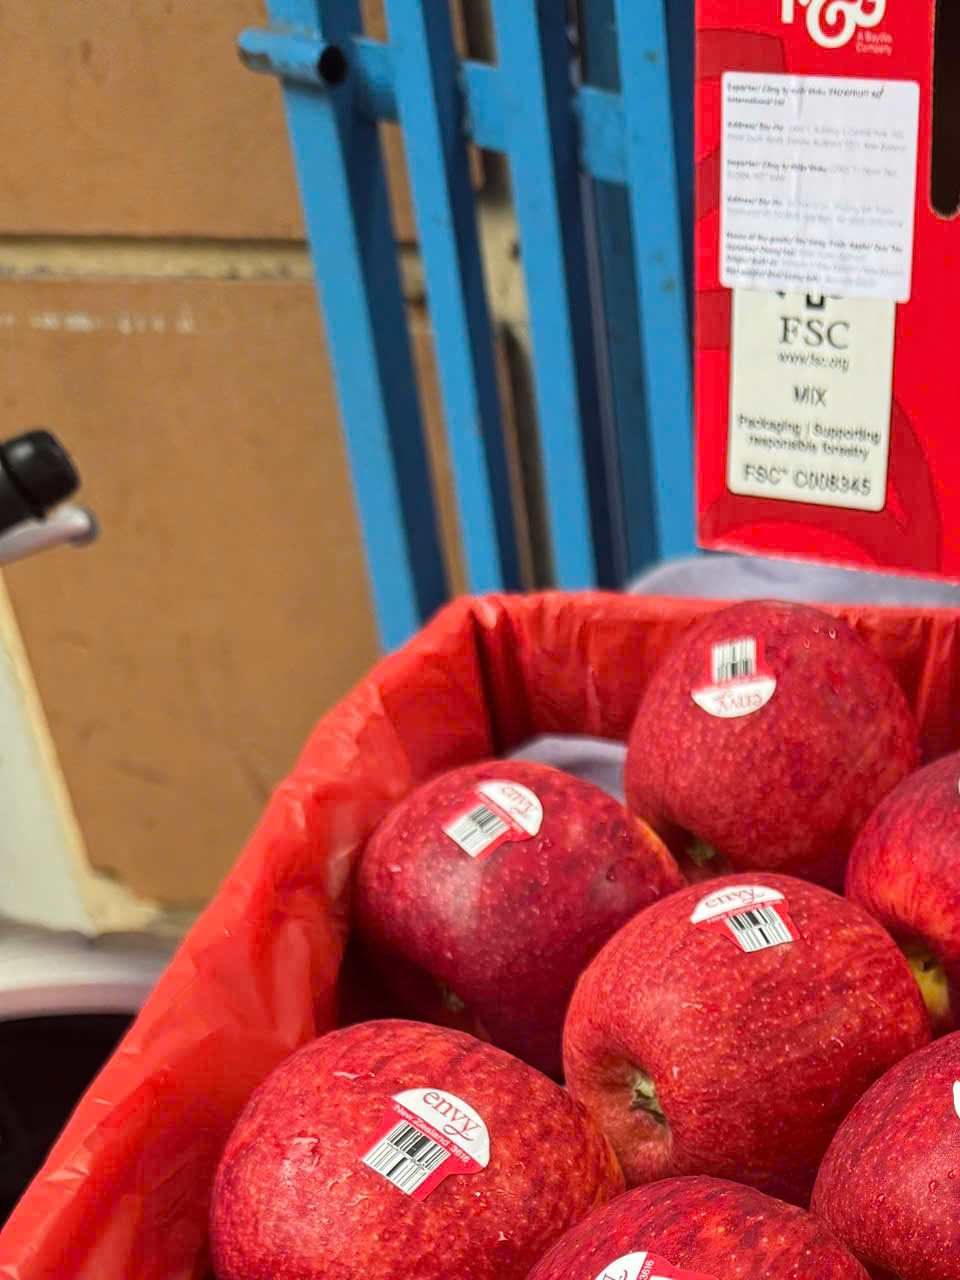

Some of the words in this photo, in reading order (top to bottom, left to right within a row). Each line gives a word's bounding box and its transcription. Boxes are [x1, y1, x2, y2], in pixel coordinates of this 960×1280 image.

[779, 316, 850, 350] FSC
[793, 384, 828, 407] MIX
[814, 422, 881, 445] Supporting
[749, 436, 817, 455] responsible
[822, 442, 869, 462] forestry
[705, 887, 764, 908] envy
[422, 1090, 482, 1141] envy
[639, 1258, 655, 1280] 3616
